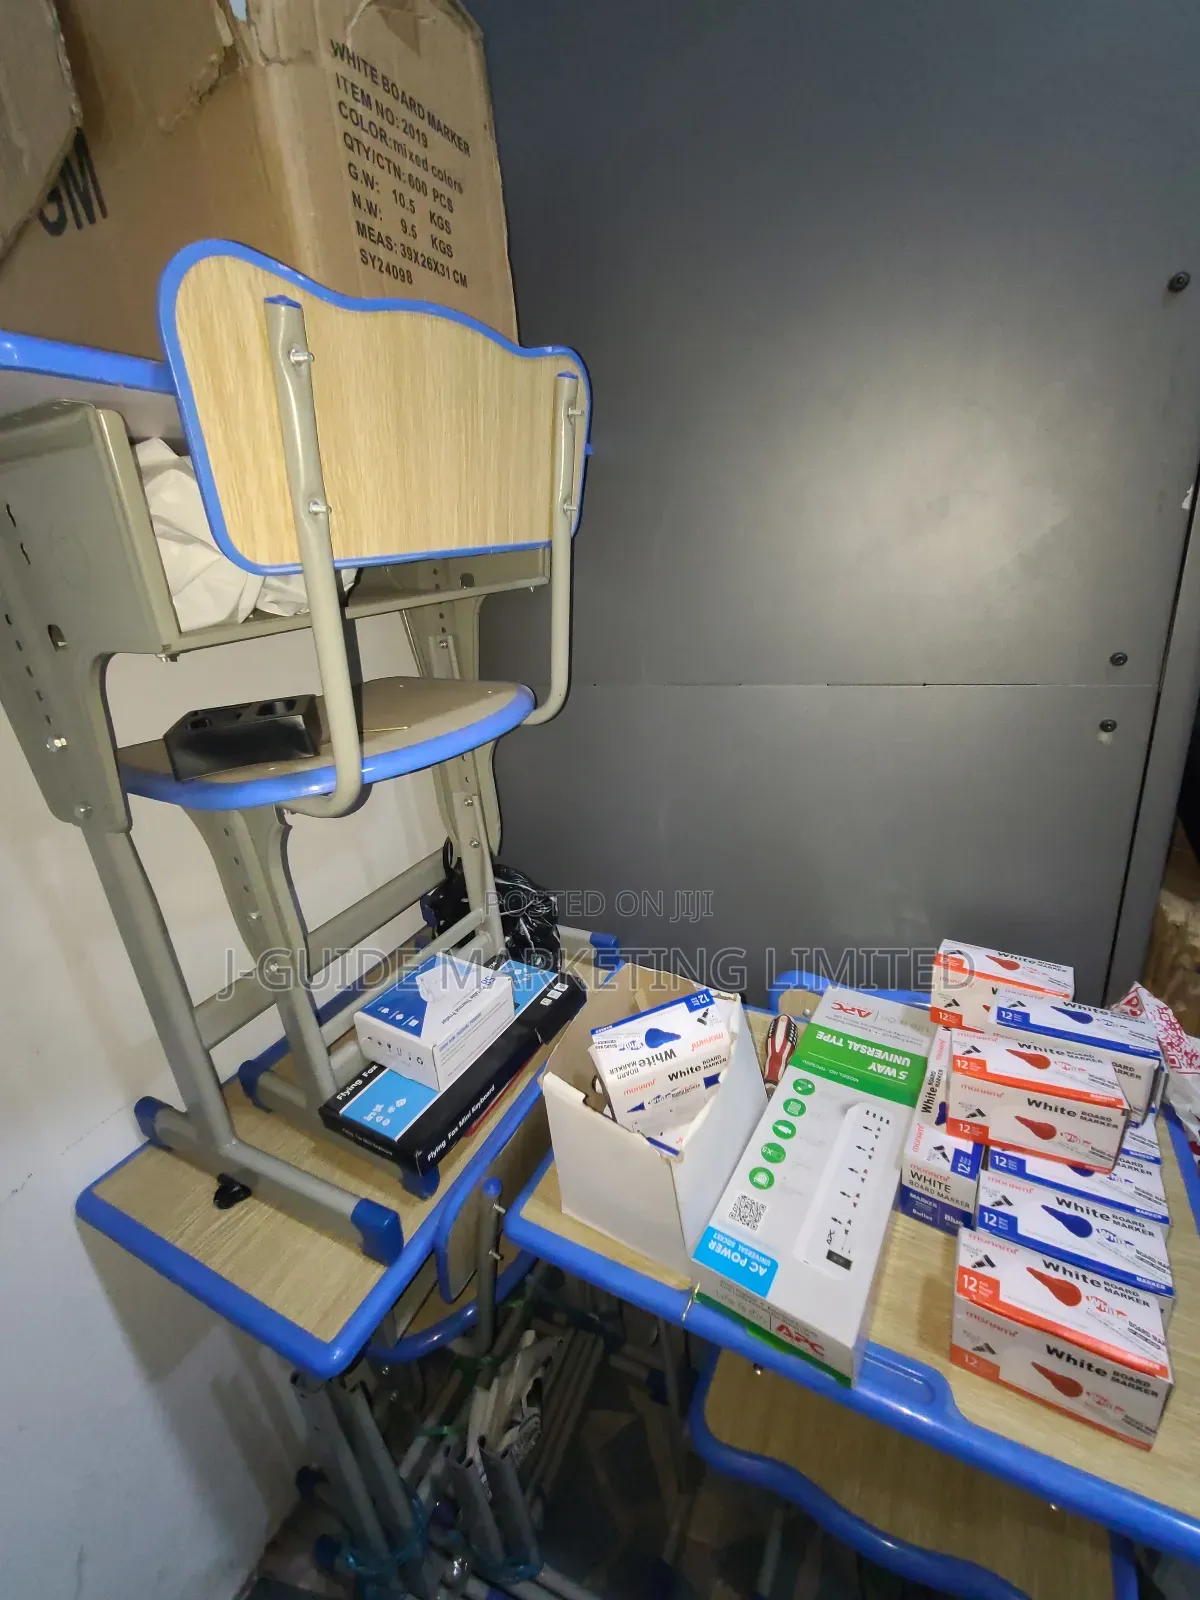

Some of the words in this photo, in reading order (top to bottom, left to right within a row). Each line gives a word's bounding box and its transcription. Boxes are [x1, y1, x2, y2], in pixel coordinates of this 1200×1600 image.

[330, 39, 380, 85] WHITE
[382, 74, 426, 120] BOARD
[427, 111, 472, 158] MARKER
[336, 72, 373, 112] ITEM
[431, 167, 465, 195] colors
[347, 162, 381, 195] G.W:
[391, 189, 416, 215] 10.5
[429, 210, 452, 235] KGS
[432, 188, 454, 214] PCS
[351, 191, 383, 222] N.W:
[400, 218, 418, 240] 9.5
[431, 234, 454, 259] KGS
[360, 248, 413, 286] SY24098
[998, 951, 1036, 965] White
[698, 994, 711, 1005] 12
[1063, 1001, 1109, 1016] White
[831, 1001, 873, 1018] APC
[938, 1011, 949, 1021] 12
[1001, 1010, 1013, 1020] 12
[1110, 1015, 1147, 1025] MARKER
[691, 1033, 724, 1052] monami
[815, 1030, 844, 1048] TYPE
[638, 1048, 677, 1068] White
[847, 1039, 912, 1068] UNIVERSAL
[1018, 1042, 1066, 1057] White
[608, 1060, 637, 1077] MARKER
[668, 1065, 701, 1082] White
[702, 1054, 722, 1066] BOARD
[703, 1057, 727, 1071] MARKER
[955, 1059, 969, 1069] 12
[1067, 1055, 1104, 1064] MARKER
[1111, 1060, 1135, 1073] OARD
[617, 1067, 639, 1081] BOARD
[867, 1062, 900, 1079] WAY
[898, 1071, 909, 1081] 5
[336, 1077, 363, 1102] Flying
[362, 1063, 379, 1079] Fox
[623, 1079, 656, 1096] monami
[961, 1083, 1005, 1099] monami
[921, 1086, 937, 1114] White
[1027, 1098, 1077, 1118] White
[1080, 1110, 1113, 1123] BOARD
[427, 1139, 447, 1162] Flying
[447, 1126, 459, 1140] Fox
[458, 1112, 473, 1129] Mini
[470, 1084, 496, 1116] Keyboard
[958, 1123, 971, 1134] 12
[1079, 1115, 1119, 1130] MARKER
[912, 1122, 925, 1153] monami
[957, 1163, 971, 1175] 12
[994, 1155, 1008, 1167] 12
[1117, 1157, 1144, 1169] OARD
[910, 1163, 951, 1183] monami
[910, 1169, 952, 1194] WHITE
[987, 1176, 1035, 1194] monami
[908, 1180, 936, 1196] BOARD
[936, 1191, 971, 1209] MARKER
[909, 1192, 938, 1209] MARKER
[983, 1211, 998, 1228] 12
[1055, 1196, 1111, 1222] White
[1112, 1213, 1146, 1229] BOARD
[1135, 1207, 1163, 1220] MARKER
[1112, 1219, 1156, 1238] MARKER
[713, 1232, 736, 1249] SOCKET
[968, 1232, 1020, 1255] monami
[708, 1239, 748, 1268] POWER
[738, 1245, 771, 1267] UNIVERSAL
[749, 1261, 768, 1277] AC
[1042, 1258, 1102, 1289] White
[1103, 1280, 1140, 1298] BOARD
[962, 1273, 978, 1293] 12
[1136, 1275, 1167, 1291] MARKER
[1104, 1286, 1151, 1309] MARKER
[966, 1310, 1019, 1338] monami
[776, 1323, 826, 1357] APC
[963, 1354, 979, 1368] 12
[1045, 1343, 1108, 1378] White
[1111, 1370, 1152, 1388] BOARD
[1110, 1376, 1159, 1398] MARKER
